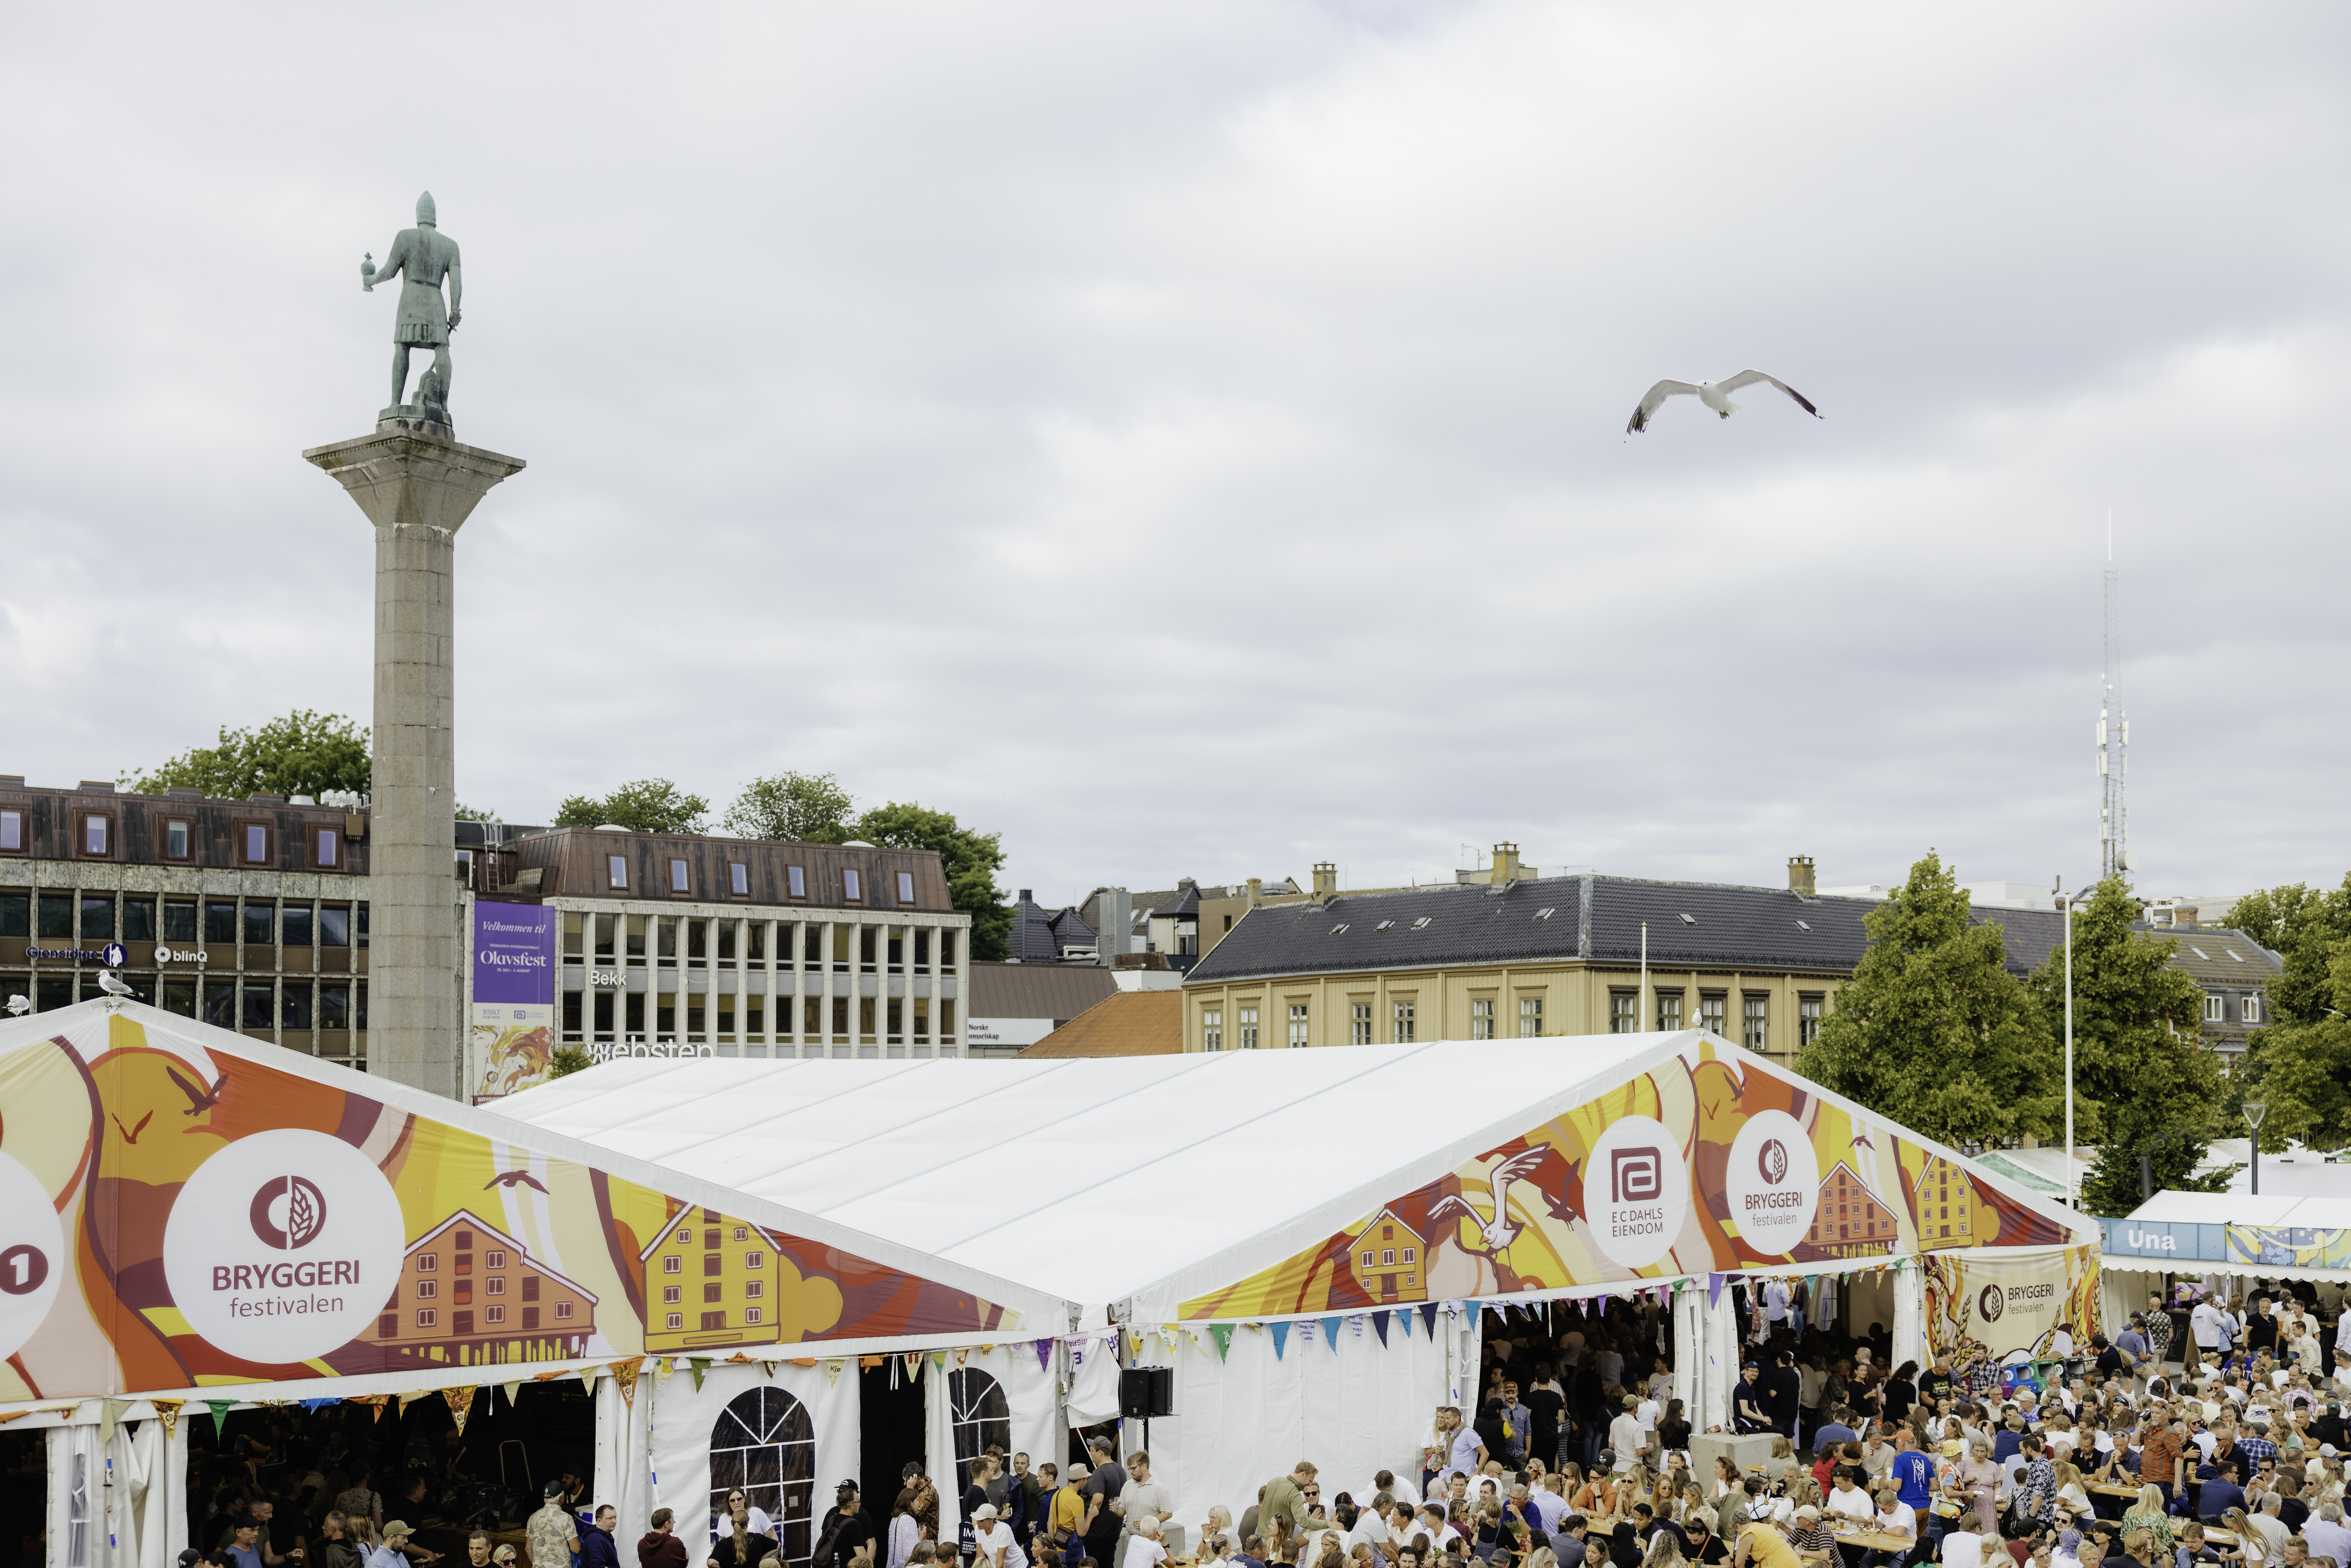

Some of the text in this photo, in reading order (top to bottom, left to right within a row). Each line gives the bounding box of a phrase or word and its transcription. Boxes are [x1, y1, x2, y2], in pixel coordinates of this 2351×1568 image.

[483, 921, 546, 934] Velkommen til
[26, 946, 98, 961] Gjensidige
[173, 950, 208, 962] blinQ
[480, 950, 547, 967] Olavsfest
[590, 970, 627, 985] Bekk
[1745, 1191, 1802, 1210] BRYGGERI
[1612, 1207, 1663, 1222] E C DAHLS
[1752, 1212, 1797, 1227] festivalen
[1612, 1221, 1663, 1237] EIENDOM
[2127, 1229, 2177, 1251] Una
[9, 1253, 30, 1285] 1
[213, 1260, 360, 1291] BRYGGERI
[2008, 1284, 2054, 1300] BRYGGERI
[230, 1293, 344, 1318] festivalen
[2008, 1301, 2044, 1315] festivalen
